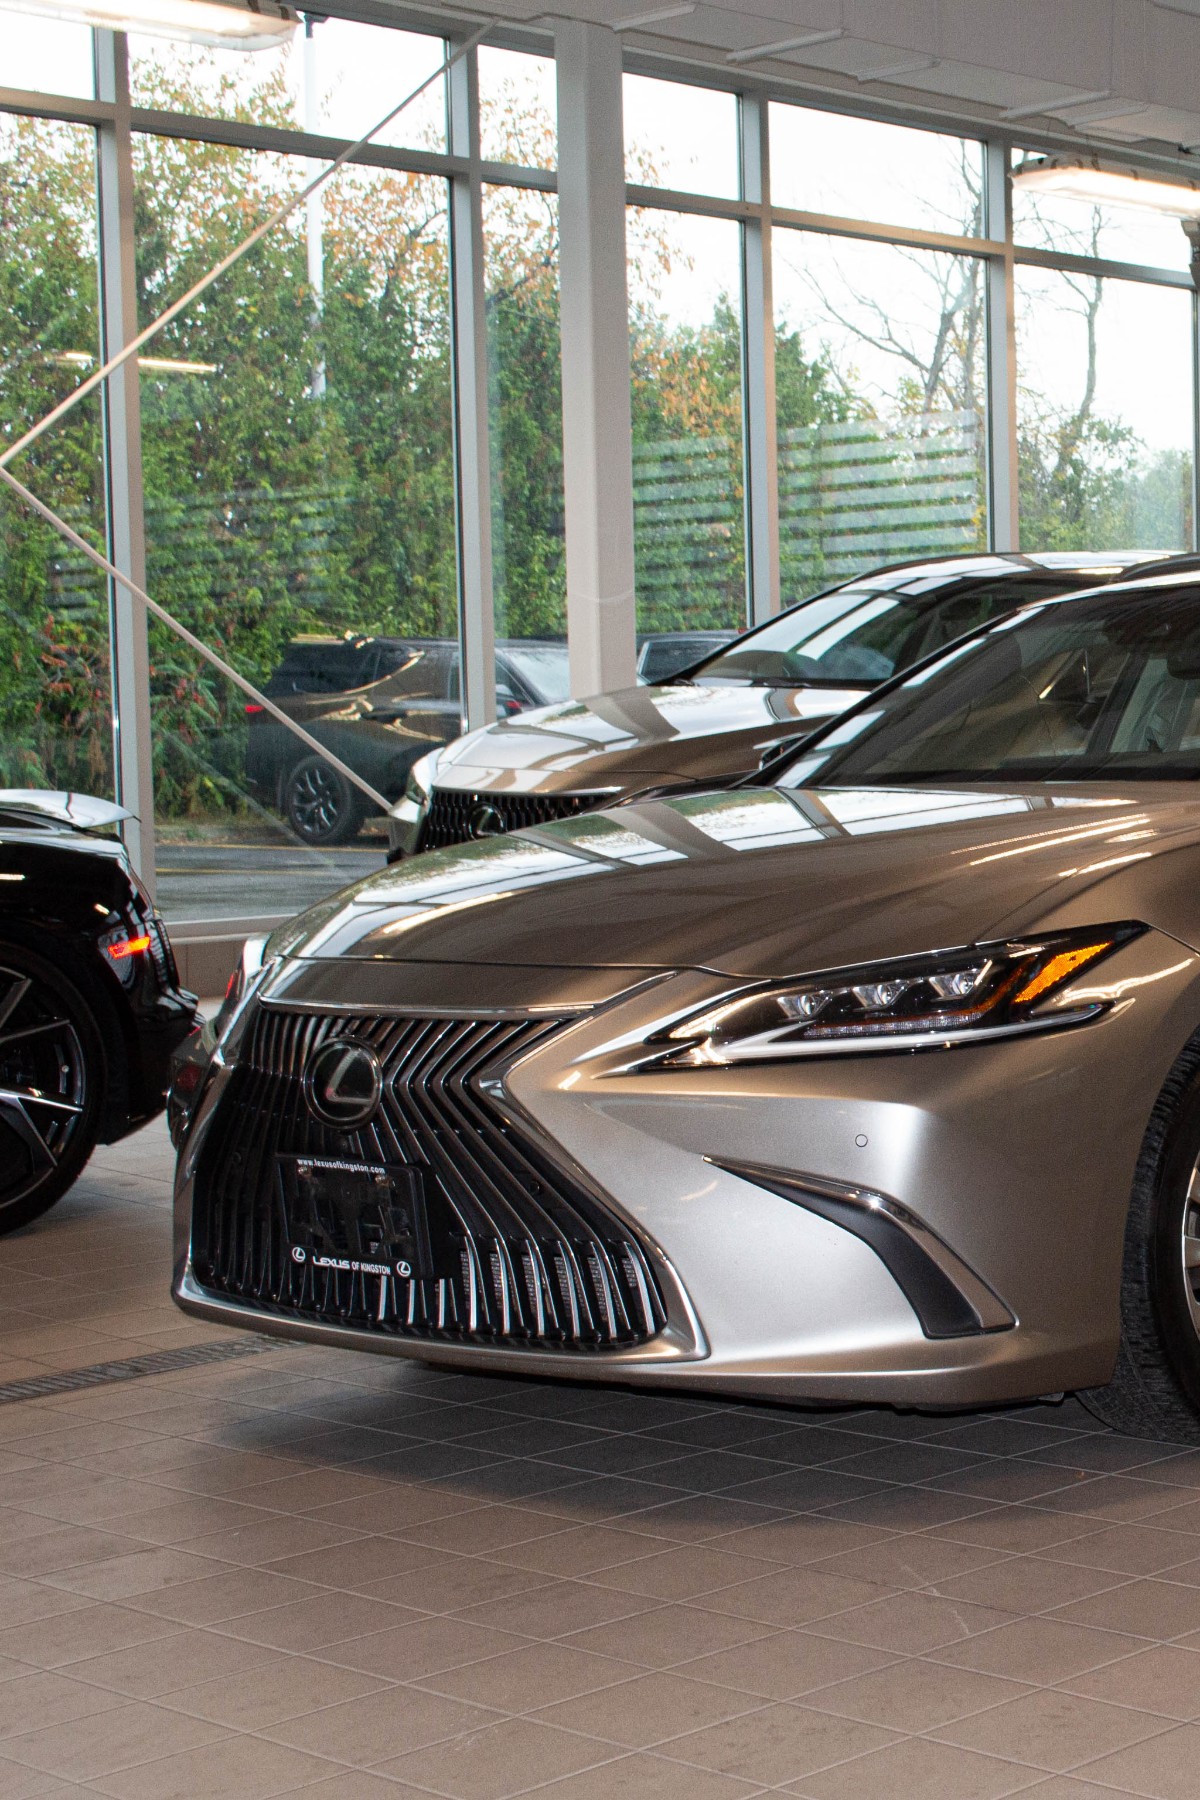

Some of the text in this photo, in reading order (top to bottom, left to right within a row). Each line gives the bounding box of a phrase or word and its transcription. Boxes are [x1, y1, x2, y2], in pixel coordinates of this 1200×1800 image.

[297, 1158, 386, 1174] www.lexusofkingston.com
[313, 1256, 350, 1269] LEXUS
[352, 1262, 359, 1271] OF
[361, 1262, 391, 1275] KINGSTON
